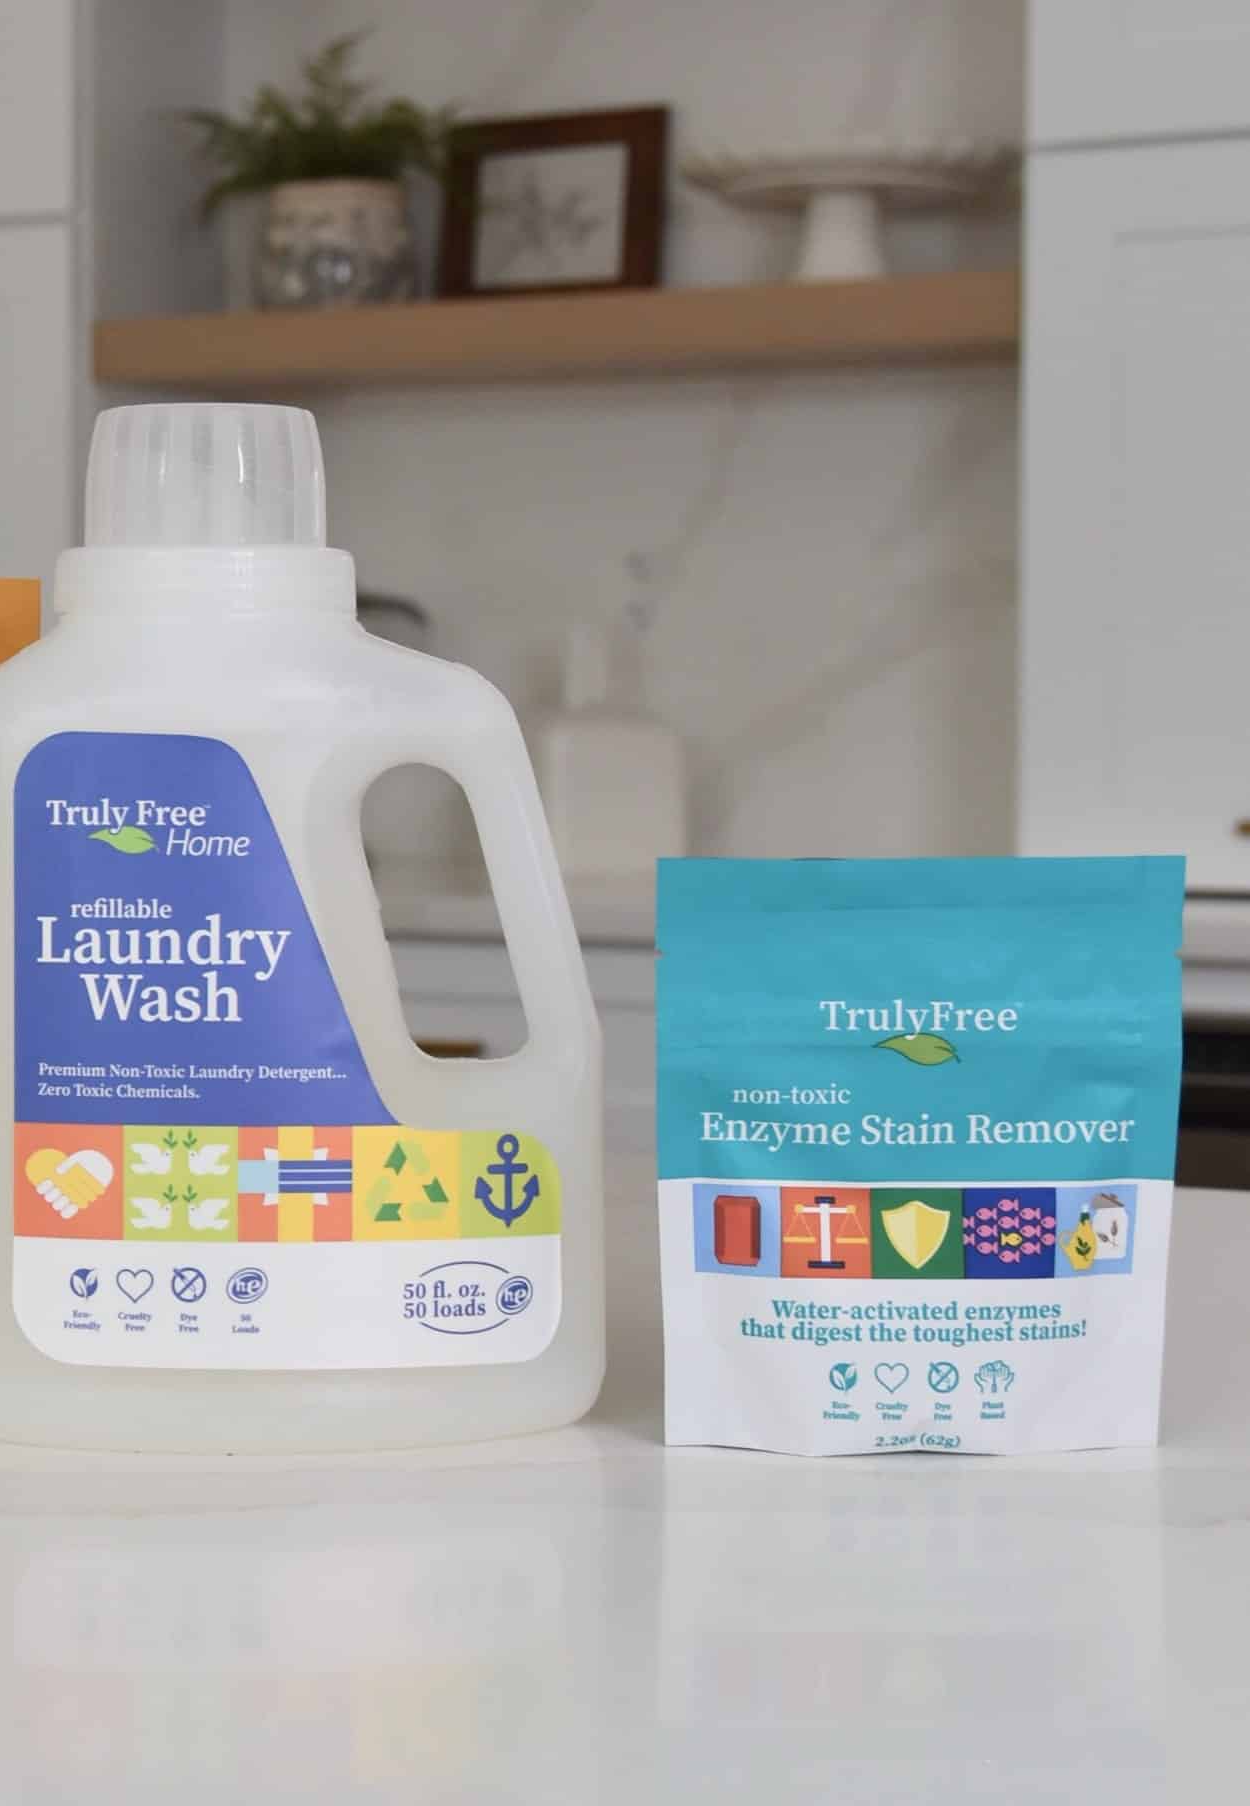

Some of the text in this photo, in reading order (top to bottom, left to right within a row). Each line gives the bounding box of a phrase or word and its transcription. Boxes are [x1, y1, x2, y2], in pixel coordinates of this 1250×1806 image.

[46, 798, 207, 835] Truly Free
[165, 828, 251, 857] Home
[70, 897, 173, 919] refillable
[36, 913, 292, 982] Laundry
[79, 970, 243, 1023] Wash
[819, 998, 1019, 1041] TrulyFree
[38, 1062, 348, 1082] Premium Non-Toxic Laundry Detergent...
[37, 1083, 202, 1099] Zero Toxic Chemicals.
[732, 1083, 852, 1106] non-toxic
[700, 1111, 1136, 1153] Enzyme Stain Remover
[403, 1280, 486, 1299] 50 fl. oz.
[403, 1299, 487, 1319] 50 loads
[772, 1299, 1062, 1324] Water-activated enzymes
[740, 1318, 1088, 1348] that digest the toughest stains!
[920, 1432, 961, 1449] (62g)
